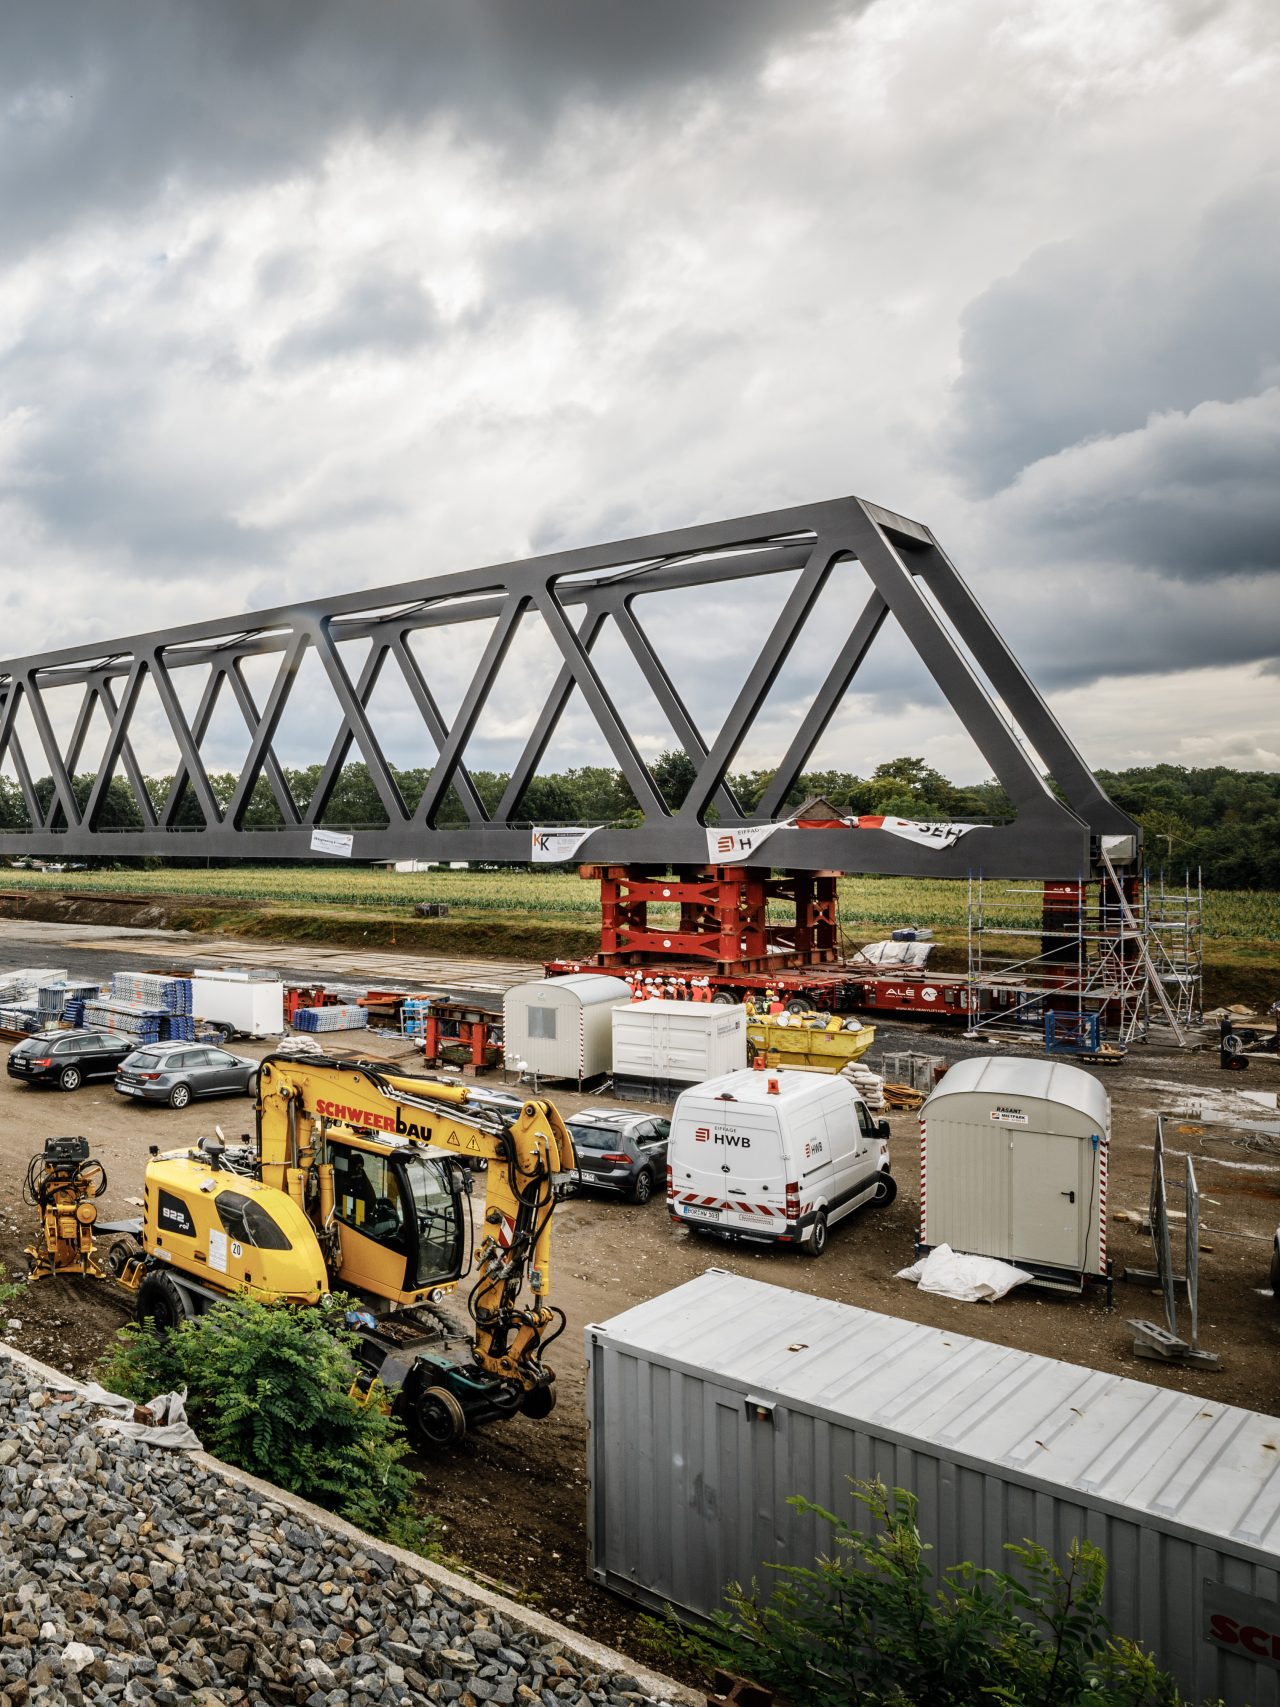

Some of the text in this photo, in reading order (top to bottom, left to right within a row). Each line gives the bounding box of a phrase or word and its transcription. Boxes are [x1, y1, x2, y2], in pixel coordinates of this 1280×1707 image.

[714, 1133, 751, 1148] HWB
[162, 1207, 185, 1223] 922
[232, 1243, 241, 1256] 20
